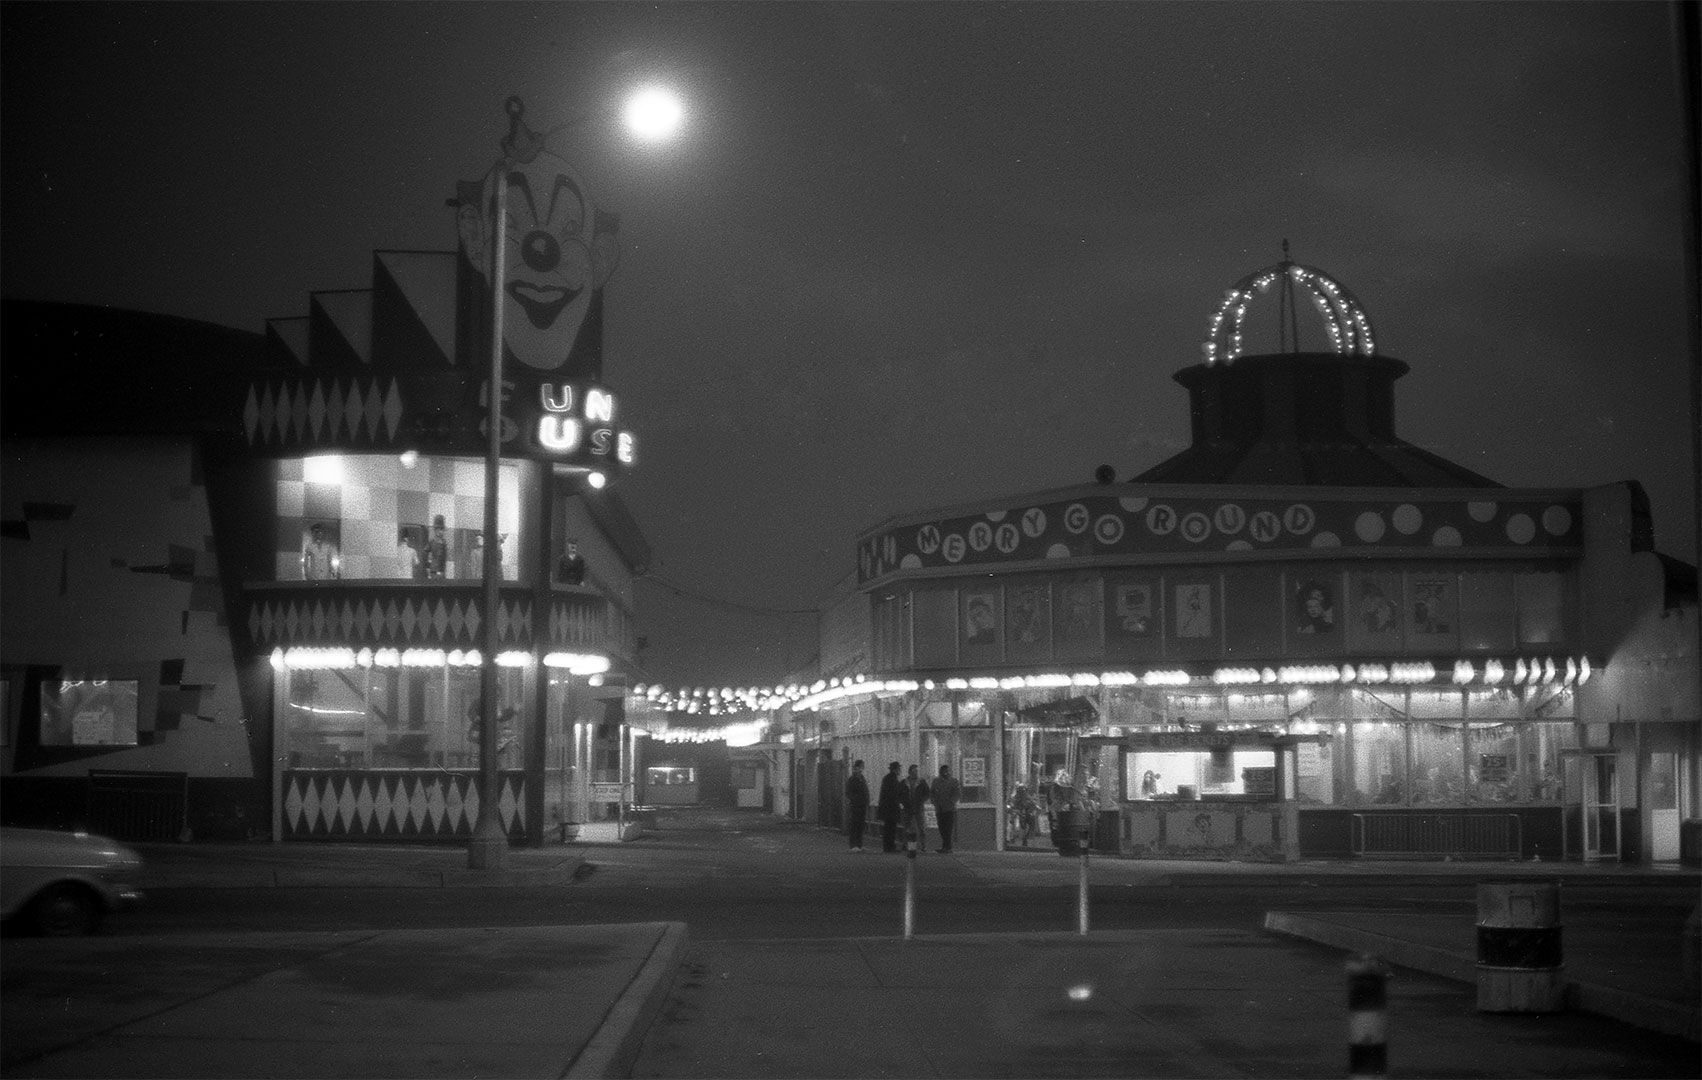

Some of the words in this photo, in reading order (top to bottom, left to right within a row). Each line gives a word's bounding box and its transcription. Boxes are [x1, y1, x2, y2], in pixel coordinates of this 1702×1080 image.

[917, 511, 1045, 560] MERRY
[1067, 506, 1121, 542] GO
[1151, 506, 1309, 542] ROUND
